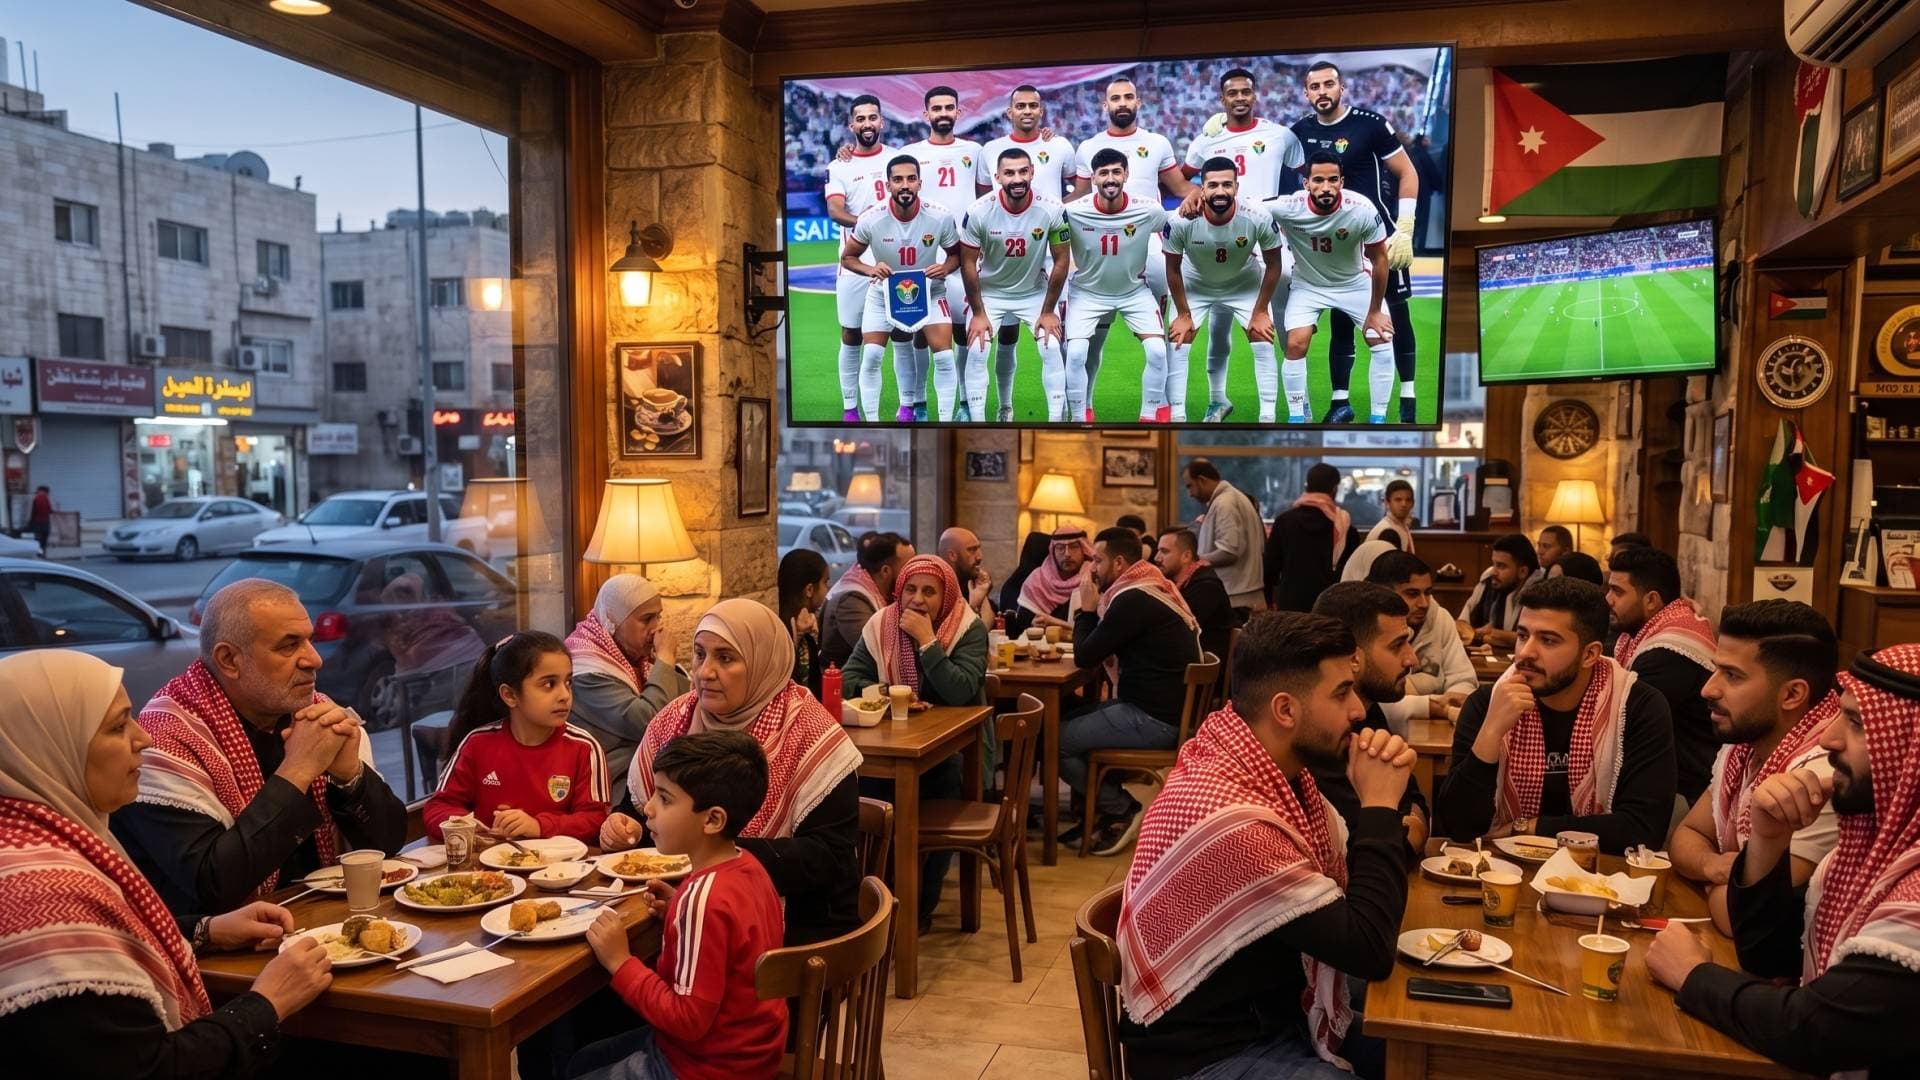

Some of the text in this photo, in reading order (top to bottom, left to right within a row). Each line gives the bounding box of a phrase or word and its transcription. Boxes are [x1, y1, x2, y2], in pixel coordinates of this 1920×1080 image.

[938, 167, 955, 187] 21
[874, 180, 885, 201] 9
[1005, 238, 1026, 257] 23
[1100, 235, 1118, 256] 11
[1310, 236, 1332, 254] 13
[898, 246, 916, 266] 10
[1215, 248, 1227, 263] 8
